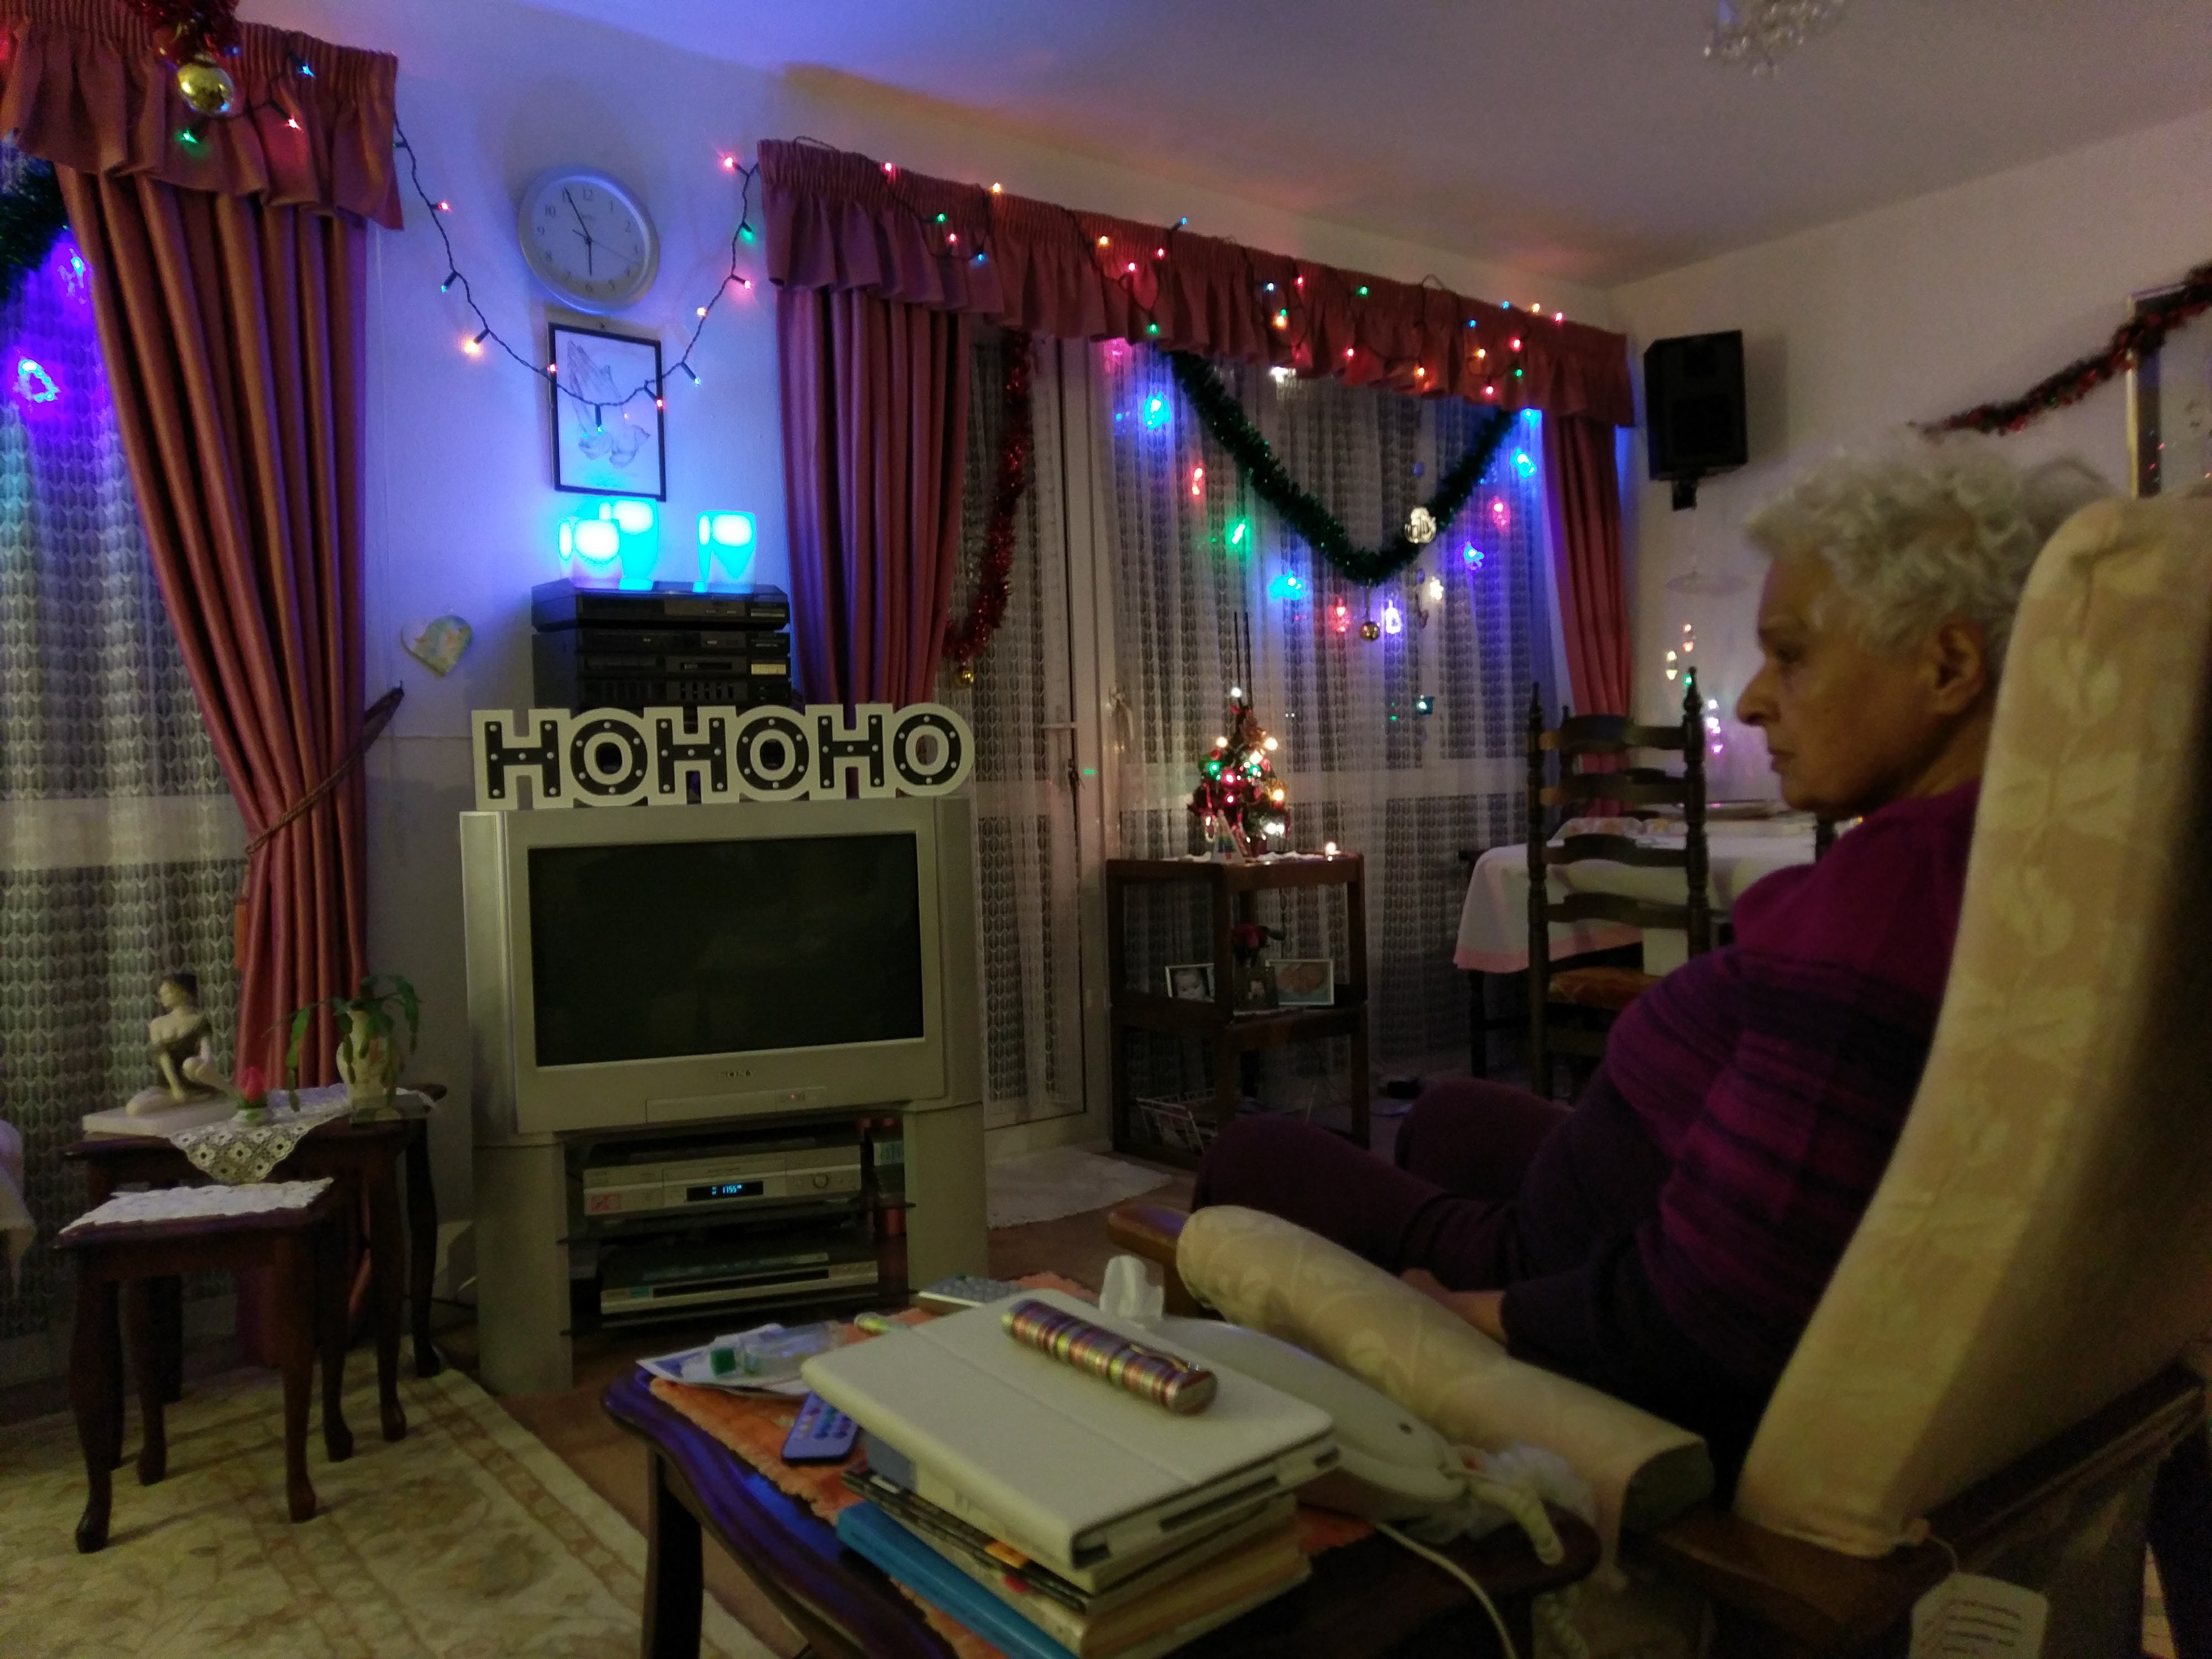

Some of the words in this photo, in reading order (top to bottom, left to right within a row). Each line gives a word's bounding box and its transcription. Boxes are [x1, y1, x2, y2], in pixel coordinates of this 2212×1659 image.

[583, 188, 593, 201] 12
[545, 204, 556, 218] 10
[536, 225, 545, 238] 9
[481, 710, 966, 803] HOHOHO
